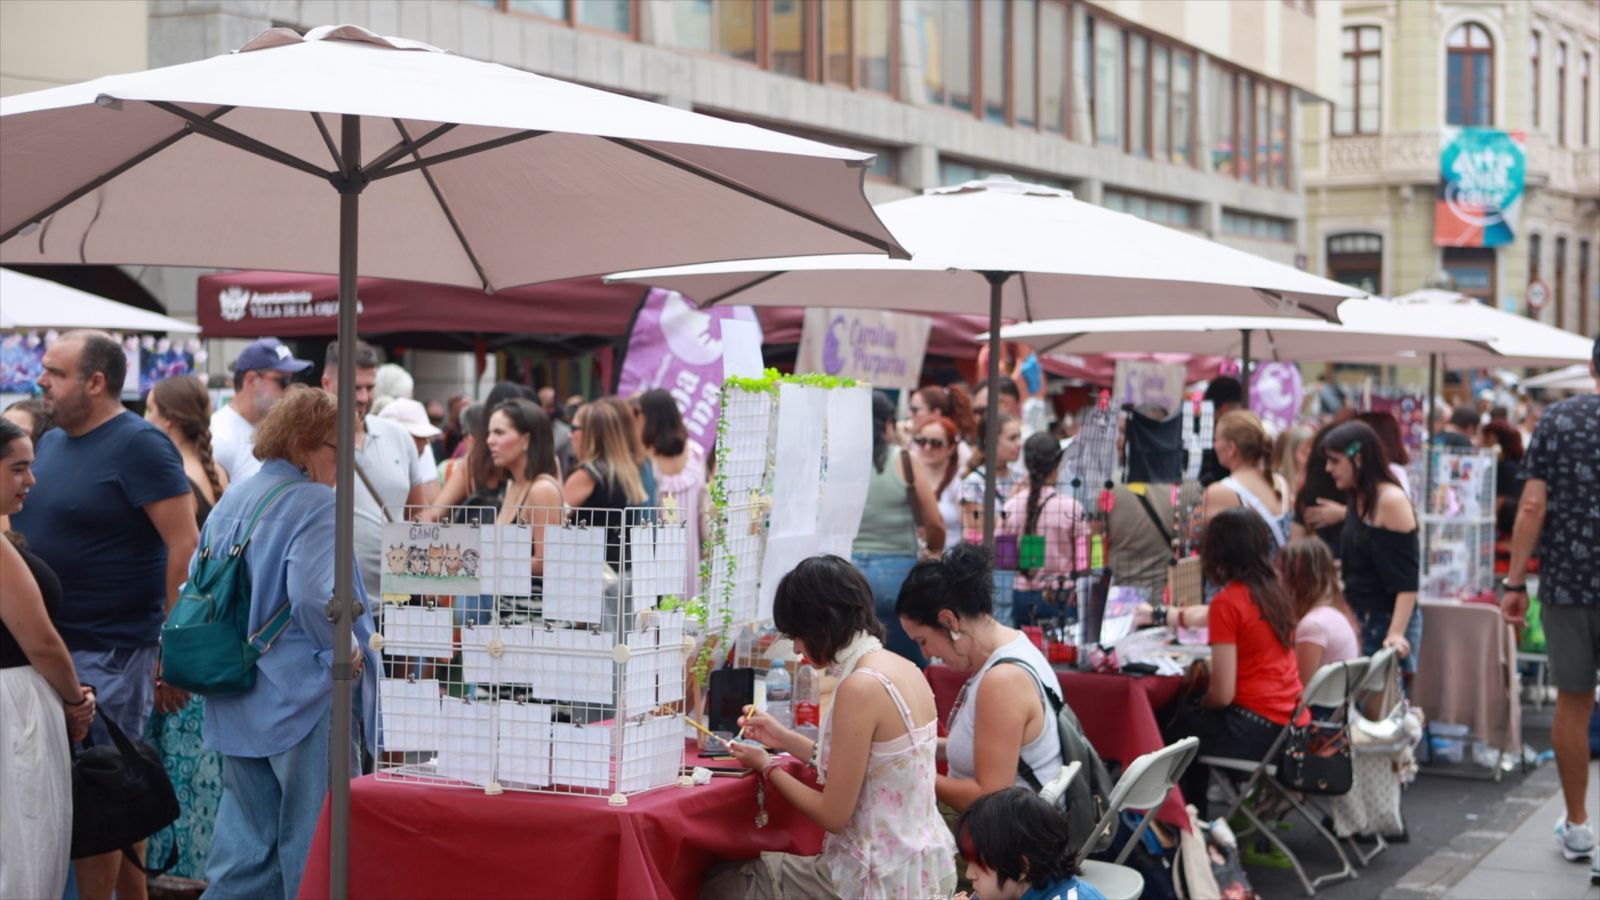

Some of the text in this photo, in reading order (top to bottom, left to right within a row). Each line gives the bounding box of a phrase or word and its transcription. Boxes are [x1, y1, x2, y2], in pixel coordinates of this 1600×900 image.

[1452, 147, 1515, 174] Arte
[250, 304, 282, 317] VILLA
[283, 303, 298, 317] DE
[299, 303, 313, 317] LA
[409, 527, 440, 540] GANG
